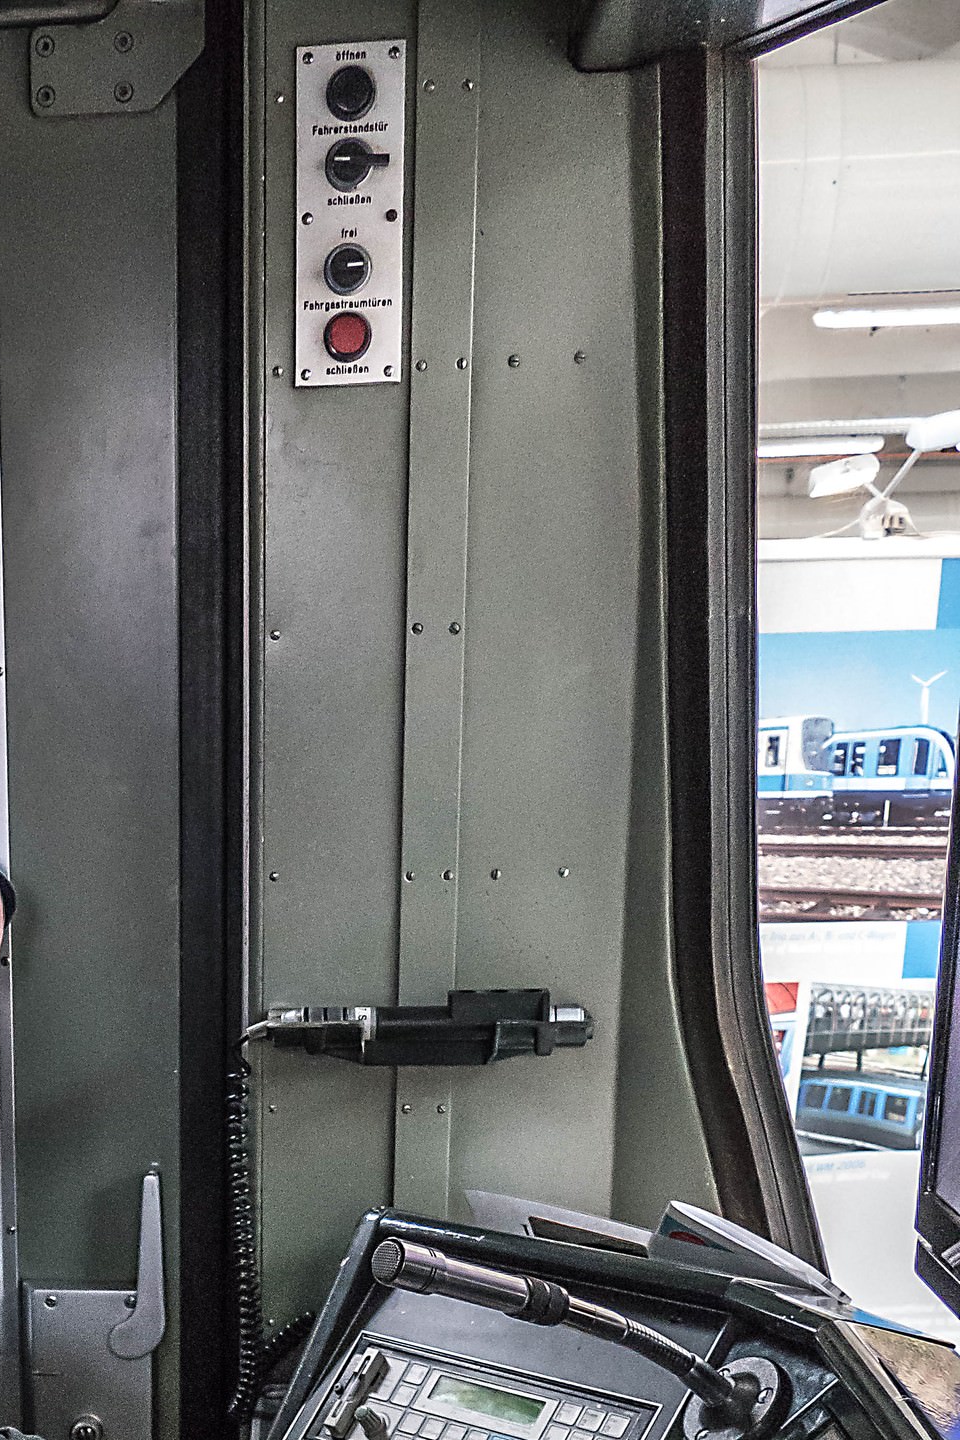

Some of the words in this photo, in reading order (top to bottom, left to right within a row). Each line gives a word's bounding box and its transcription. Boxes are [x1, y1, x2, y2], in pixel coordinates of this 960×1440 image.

[335, 49, 367, 61] öffnen
[312, 121, 389, 137] Fahrerstandstür
[327, 194, 372, 206] schließen
[341, 227, 358, 239] frei
[303, 297, 393, 311] Fahrgastraumtüren
[326, 363, 370, 376] schließen
